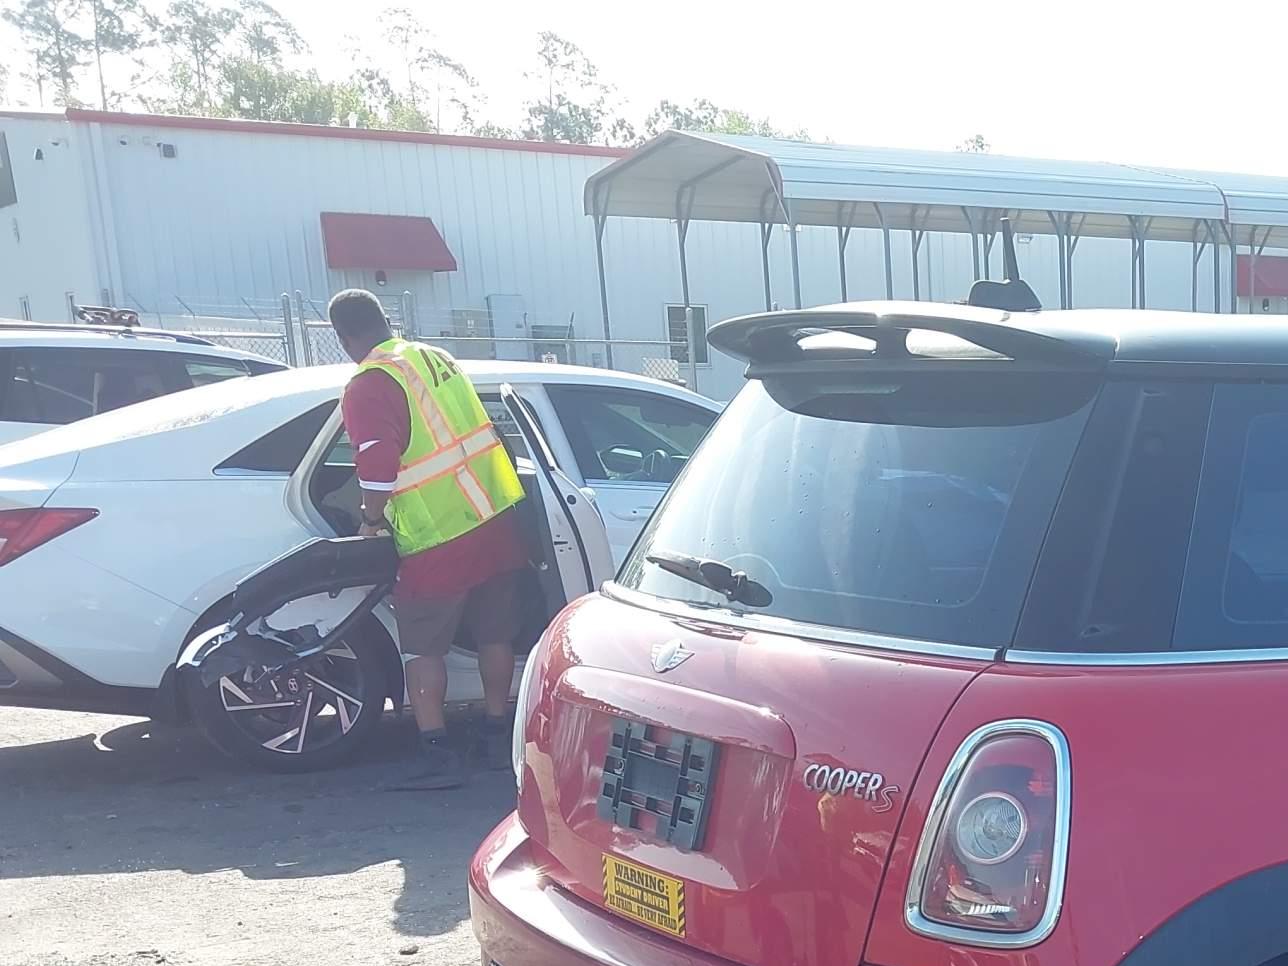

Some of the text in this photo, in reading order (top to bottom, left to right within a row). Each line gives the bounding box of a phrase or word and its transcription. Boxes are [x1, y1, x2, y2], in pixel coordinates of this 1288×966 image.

[803, 763, 900, 814] COOPER S
[614, 861, 670, 896] WARNING:
[615, 880, 669, 913] STUDENT DRIVER
